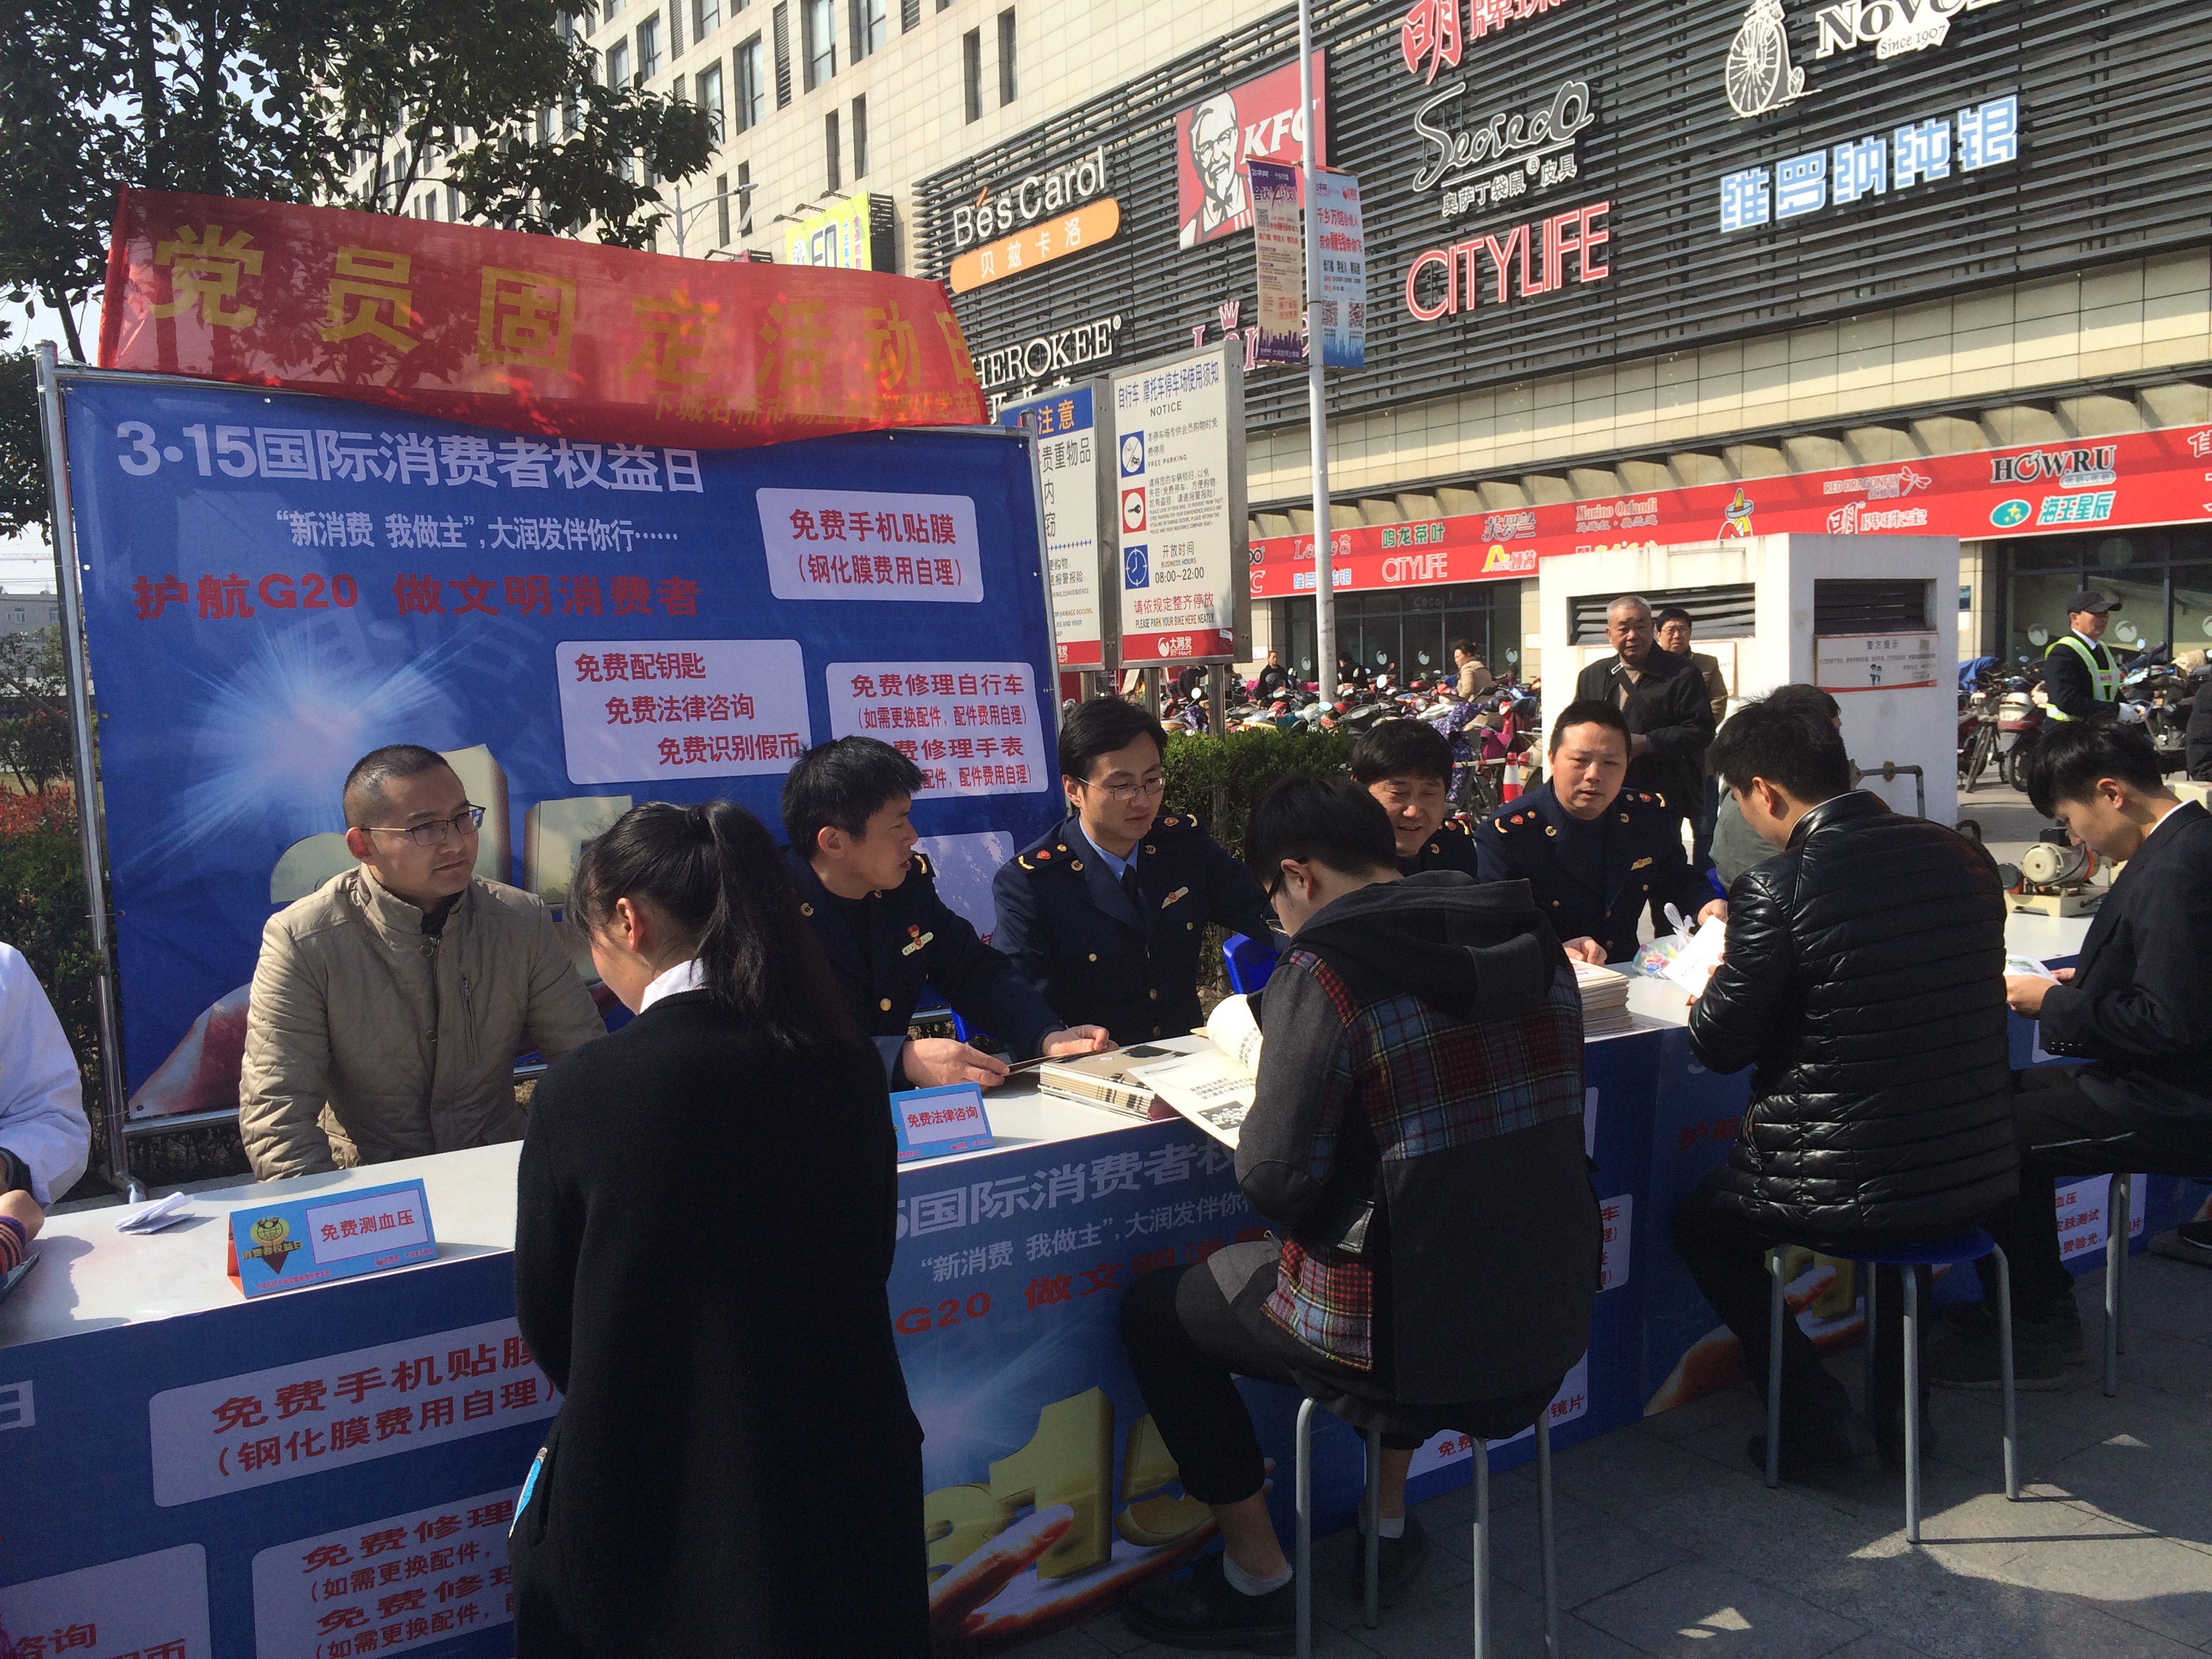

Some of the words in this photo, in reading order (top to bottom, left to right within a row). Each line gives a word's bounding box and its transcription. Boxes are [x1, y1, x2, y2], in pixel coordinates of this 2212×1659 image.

[1880, 36, 1912, 55] Since
[1917, 25, 1946, 46] 1907
[1721, 95, 2018, 234] 维罗纳纯银
[1441, 170, 1527, 218] 奥萨丁袋鼠
[1540, 154, 1578, 188] 皮具
[980, 217, 1082, 279] 贝兹卡洛
[1405, 201, 1610, 321] CITYLIFE
[972, 326, 1113, 390] HEROKEE
[1119, 382, 1139, 411] 自行车
[1143, 361, 1219, 403] 摩托车停车场使用须知
[1038, 399, 1075, 435] 注意
[1150, 401, 1182, 417] NOTICE
[117, 419, 705, 495] 3·15国际消费者权益日
[1038, 436, 1091, 474] 贵重物品
[1148, 459, 1161, 468] FREE
[1163, 454, 1187, 465] PARKING
[1576, 504, 1614, 521] Marino
[1615, 497, 1658, 516] Orlandi
[2036, 490, 2116, 526] 海王星辰
[790, 508, 956, 546] 免费手机贴膜
[1382, 522, 1445, 549] 鸣龙茶叶
[1161, 559, 1181, 568] BUSINESS
[1182, 558, 1197, 566] HOURS
[1162, 541, 1194, 558] 开放时间
[798, 552, 962, 588] (钢化膜费用自理)
[1382, 552, 1448, 582] CITYLIFE
[133, 573, 359, 619] 护航G20
[391, 573, 701, 618] 做文明消费者
[1134, 592, 1214, 615] 请依规定整齐停放
[1136, 619, 1150, 629] PLEASE
[1151, 617, 1162, 628] PARK
[1162, 617, 1174, 626] YOUR
[1174, 615, 1185, 626] BIKE
[1185, 615, 1197, 625] HERE
[1197, 613, 1214, 623] NEATLY
[1170, 636, 1193, 649] 大润发
[575, 651, 707, 682] 免费配钥匙
[851, 673, 1025, 699] 免费修理自行车
[605, 693, 755, 726] 免费法律咨询
[857, 705, 1027, 731] (如需更换配件，配件费用自理)
[657, 732, 800, 766] 免费识别假币
[893, 736, 1025, 762] 费修理手表
[922, 763, 1032, 790] 配件，配件费用自理)
[907, 1105, 978, 1128] 免费法律咨询
[321, 1209, 415, 1242] 免费测血压
[218, 1376, 556, 1478] (钢化膜费用自理)
[302, 1498, 514, 1574] 免费修理
